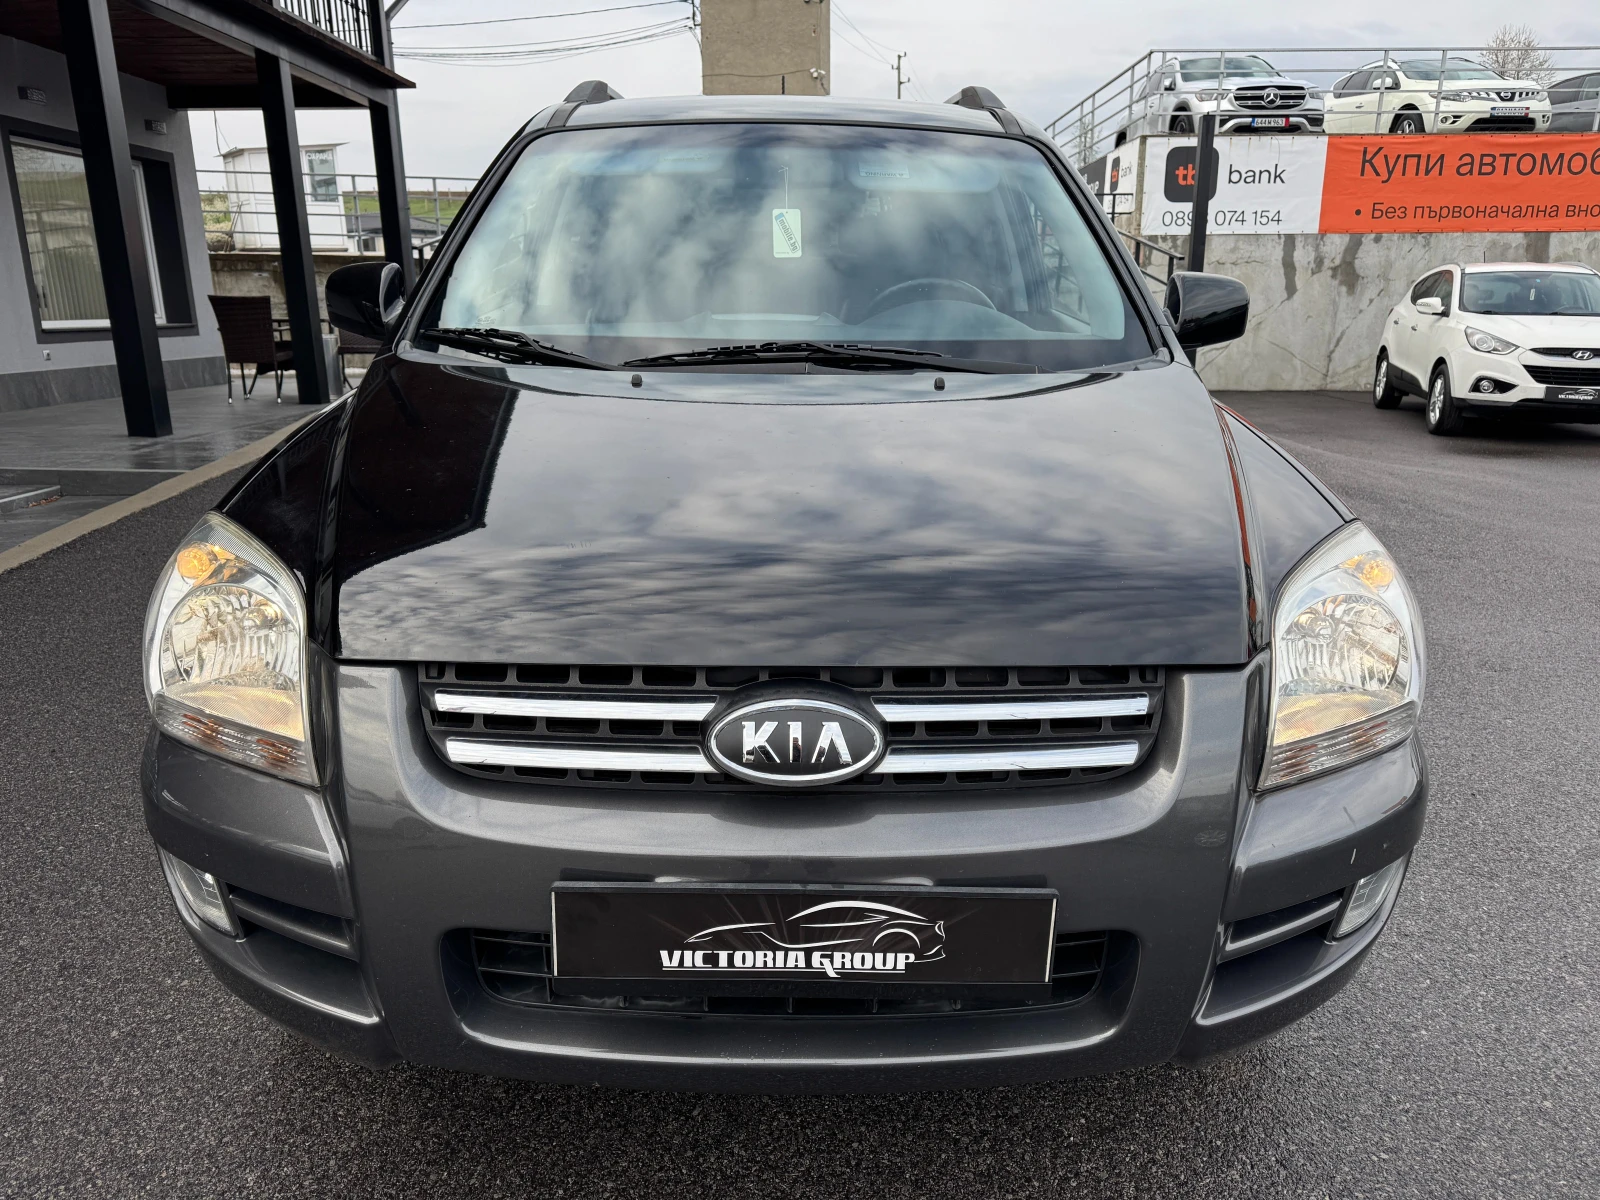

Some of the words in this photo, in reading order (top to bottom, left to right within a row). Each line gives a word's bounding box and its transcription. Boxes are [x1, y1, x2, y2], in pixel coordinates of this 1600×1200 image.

[1228, 163, 1287, 184] bank
[1360, 146, 1445, 183] Купи
[1215, 210, 1247, 226] 074
[1252, 210, 1282, 226] 154
[1371, 202, 1407, 219] Без
[1413, 204, 1559, 222] първоначална
[741, 721, 853, 764] KIA
[659, 950, 806, 969] VICTORIA
[811, 951, 916, 977] GROUP
